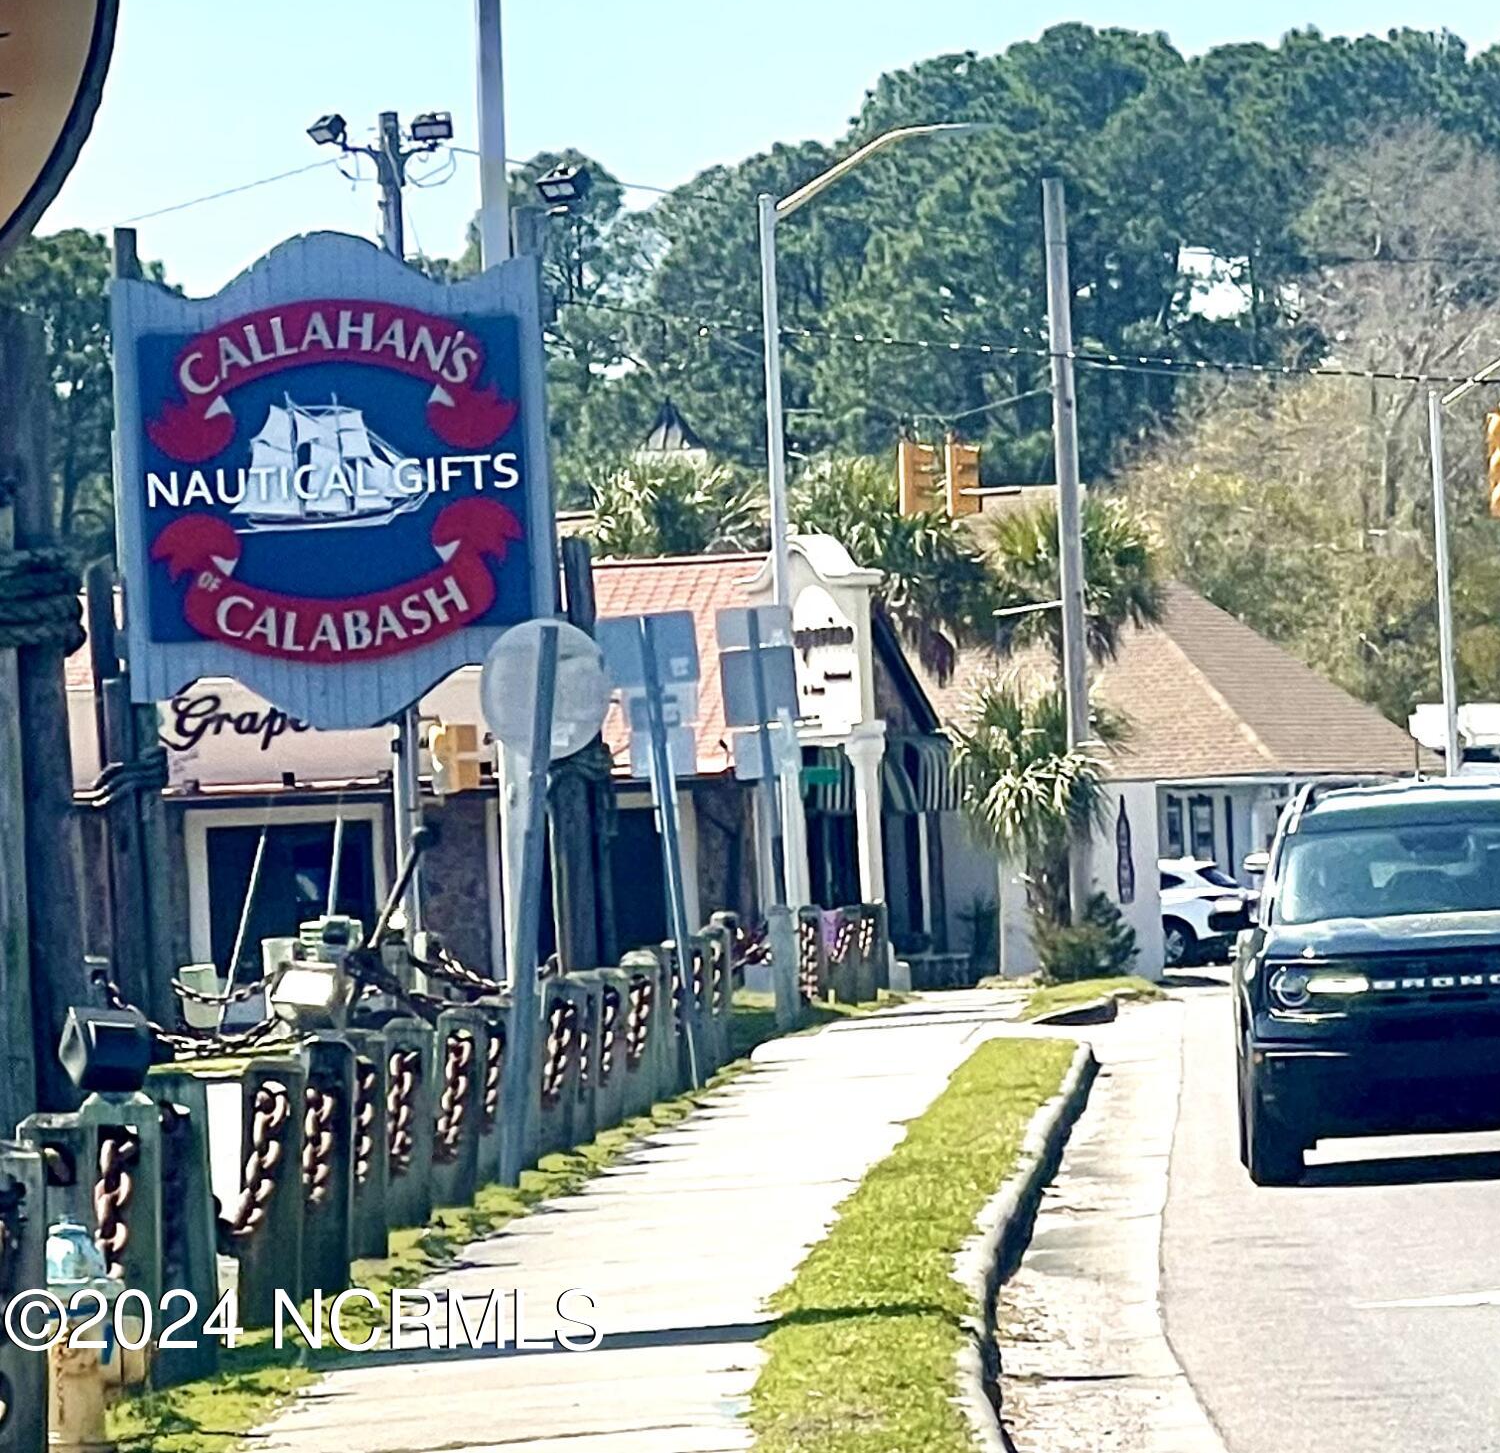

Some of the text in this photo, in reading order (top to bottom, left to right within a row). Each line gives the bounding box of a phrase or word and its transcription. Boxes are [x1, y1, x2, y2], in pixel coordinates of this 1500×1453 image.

[178, 310, 478, 395] CALLAHAN'S
[146, 453, 519, 508] NAUTICAL GIFTS
[198, 570, 221, 593] OF
[216, 575, 470, 652] CALABASH
